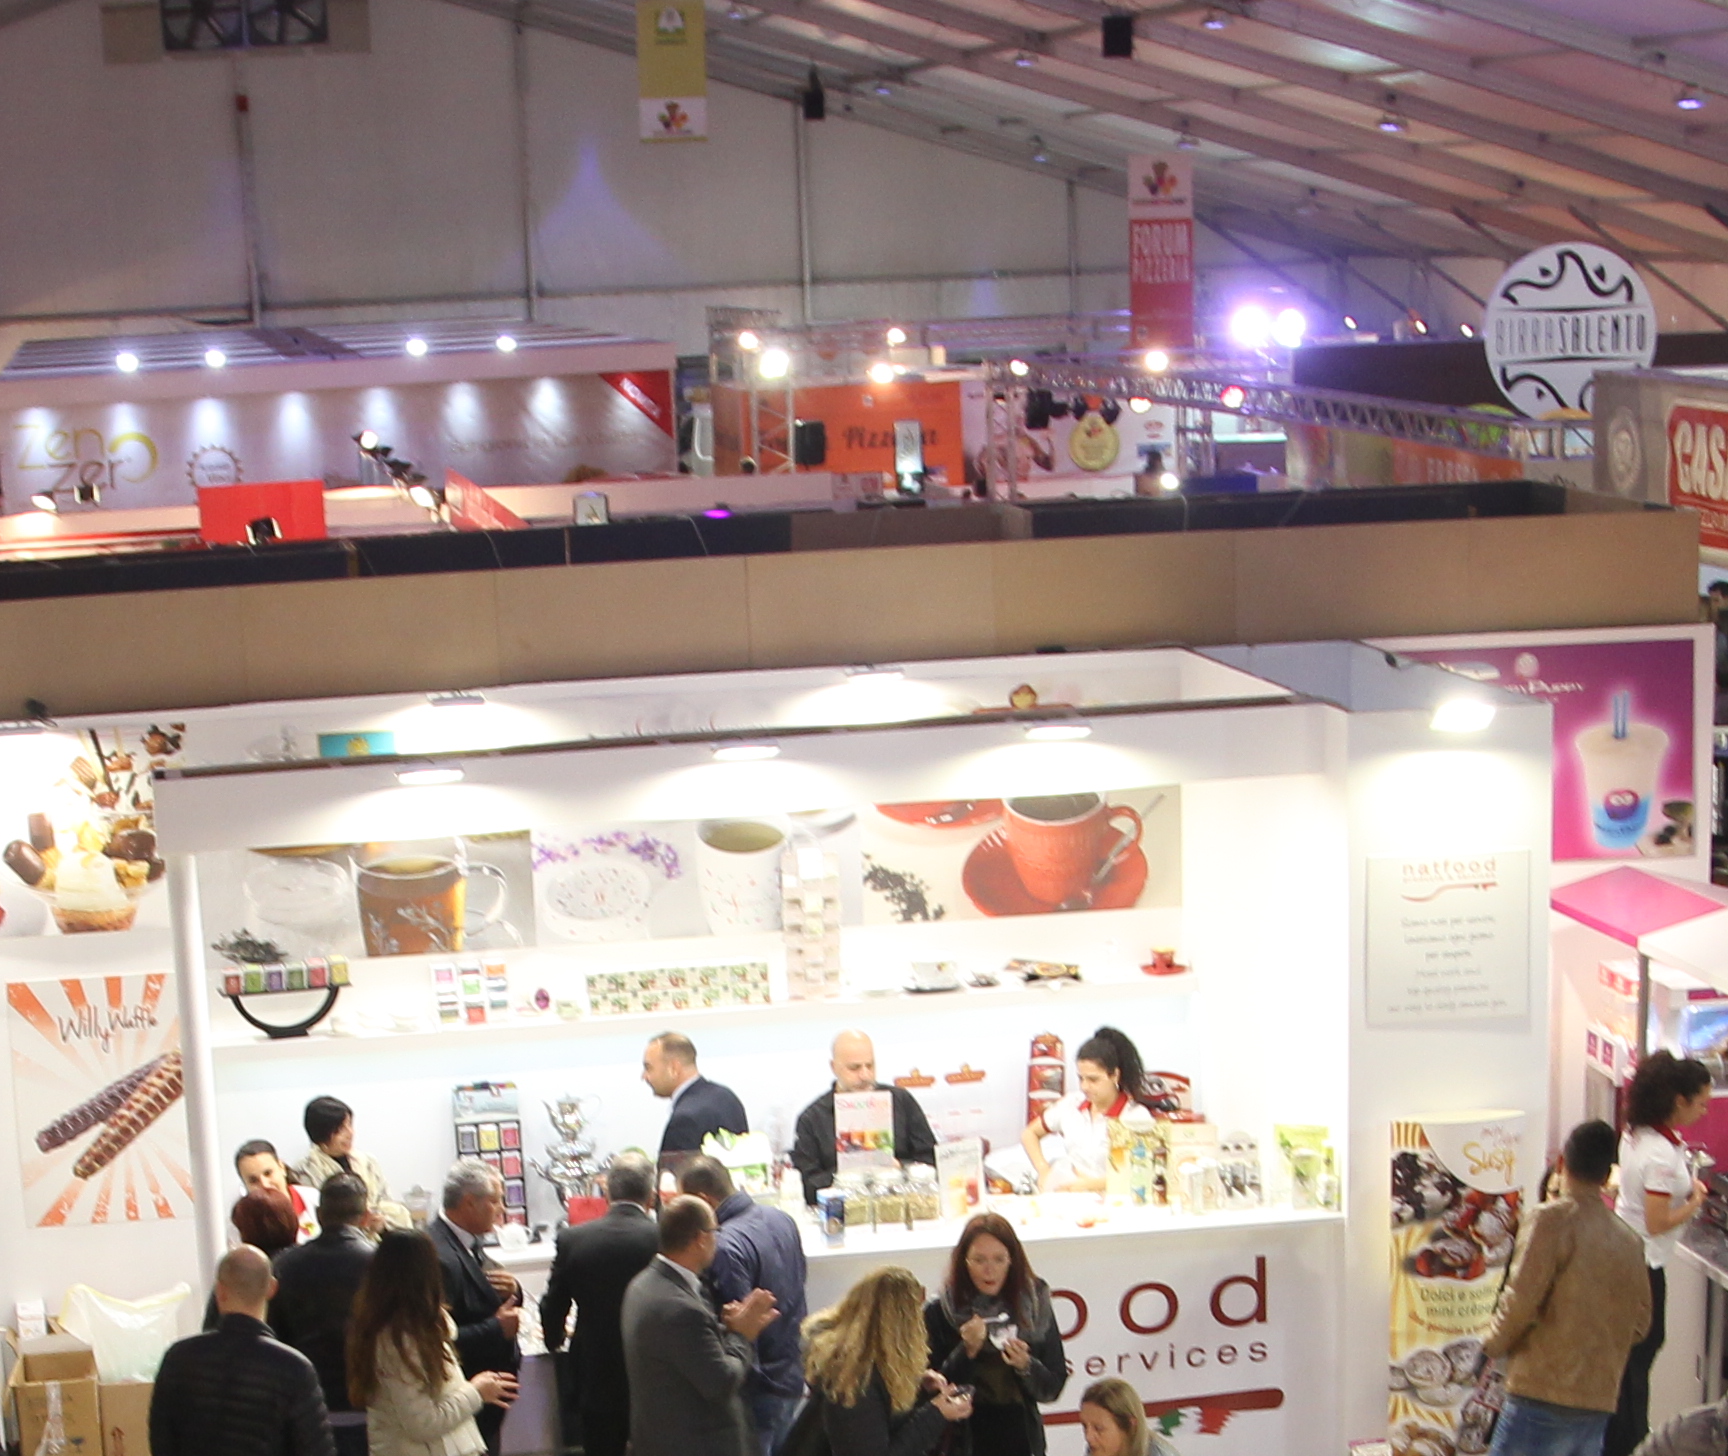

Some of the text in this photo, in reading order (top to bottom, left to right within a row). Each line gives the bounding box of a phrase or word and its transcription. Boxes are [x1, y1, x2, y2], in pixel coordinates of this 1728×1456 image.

[1132, 223, 1189, 256] FORUM
[1402, 856, 1497, 877] natfood
[57, 1003, 113, 1054] Willy
[1462, 1141, 1518, 1187] Susy
[1064, 1341, 1269, 1378] services
